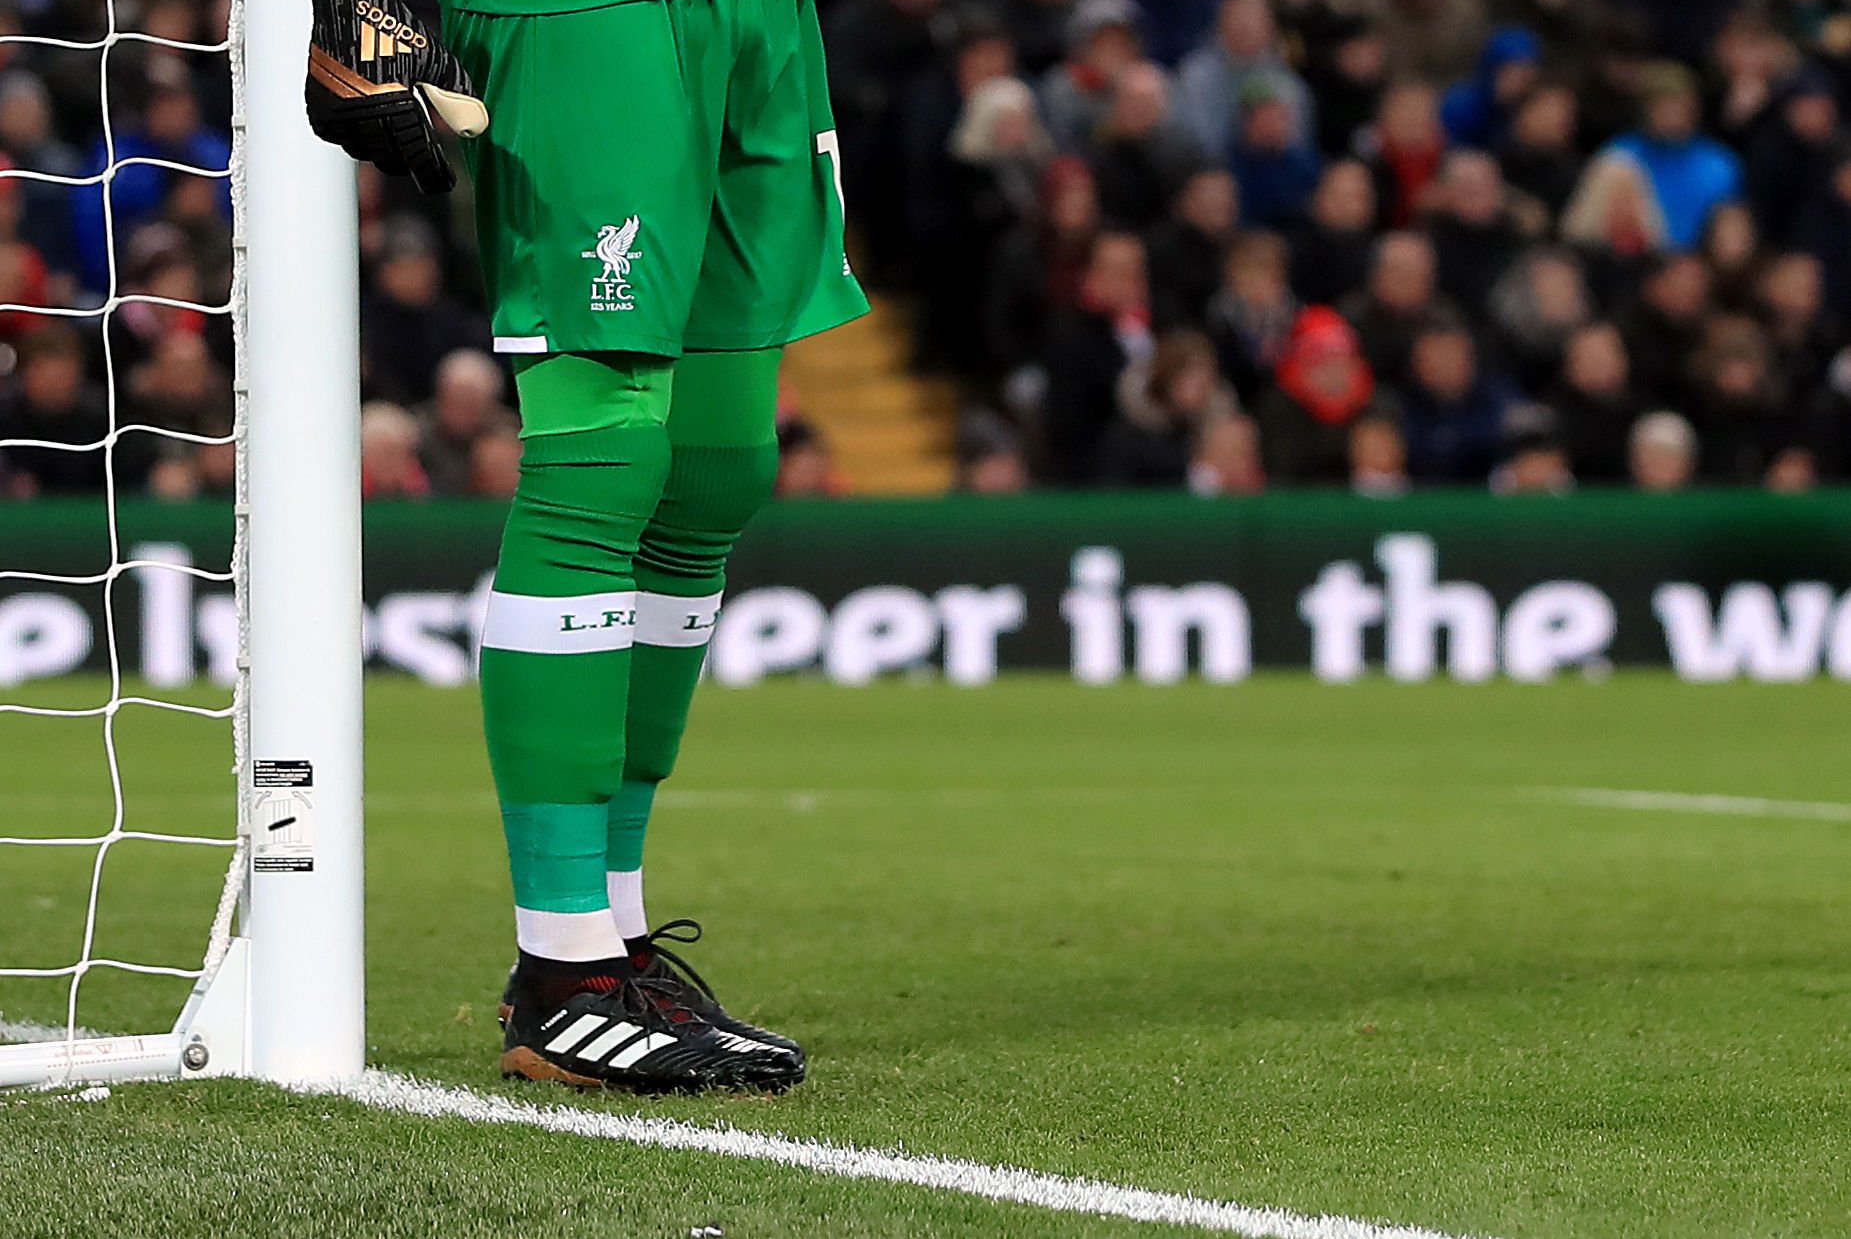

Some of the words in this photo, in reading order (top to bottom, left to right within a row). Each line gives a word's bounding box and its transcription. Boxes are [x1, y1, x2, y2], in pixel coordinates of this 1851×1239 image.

[355, 0, 428, 49] adidas
[590, 283, 635, 301] L.F.C.
[700, 584, 1028, 688] eer
[1060, 544, 1254, 686] in
[1299, 532, 1617, 686] the
[1650, 580, 1851, 686] w
